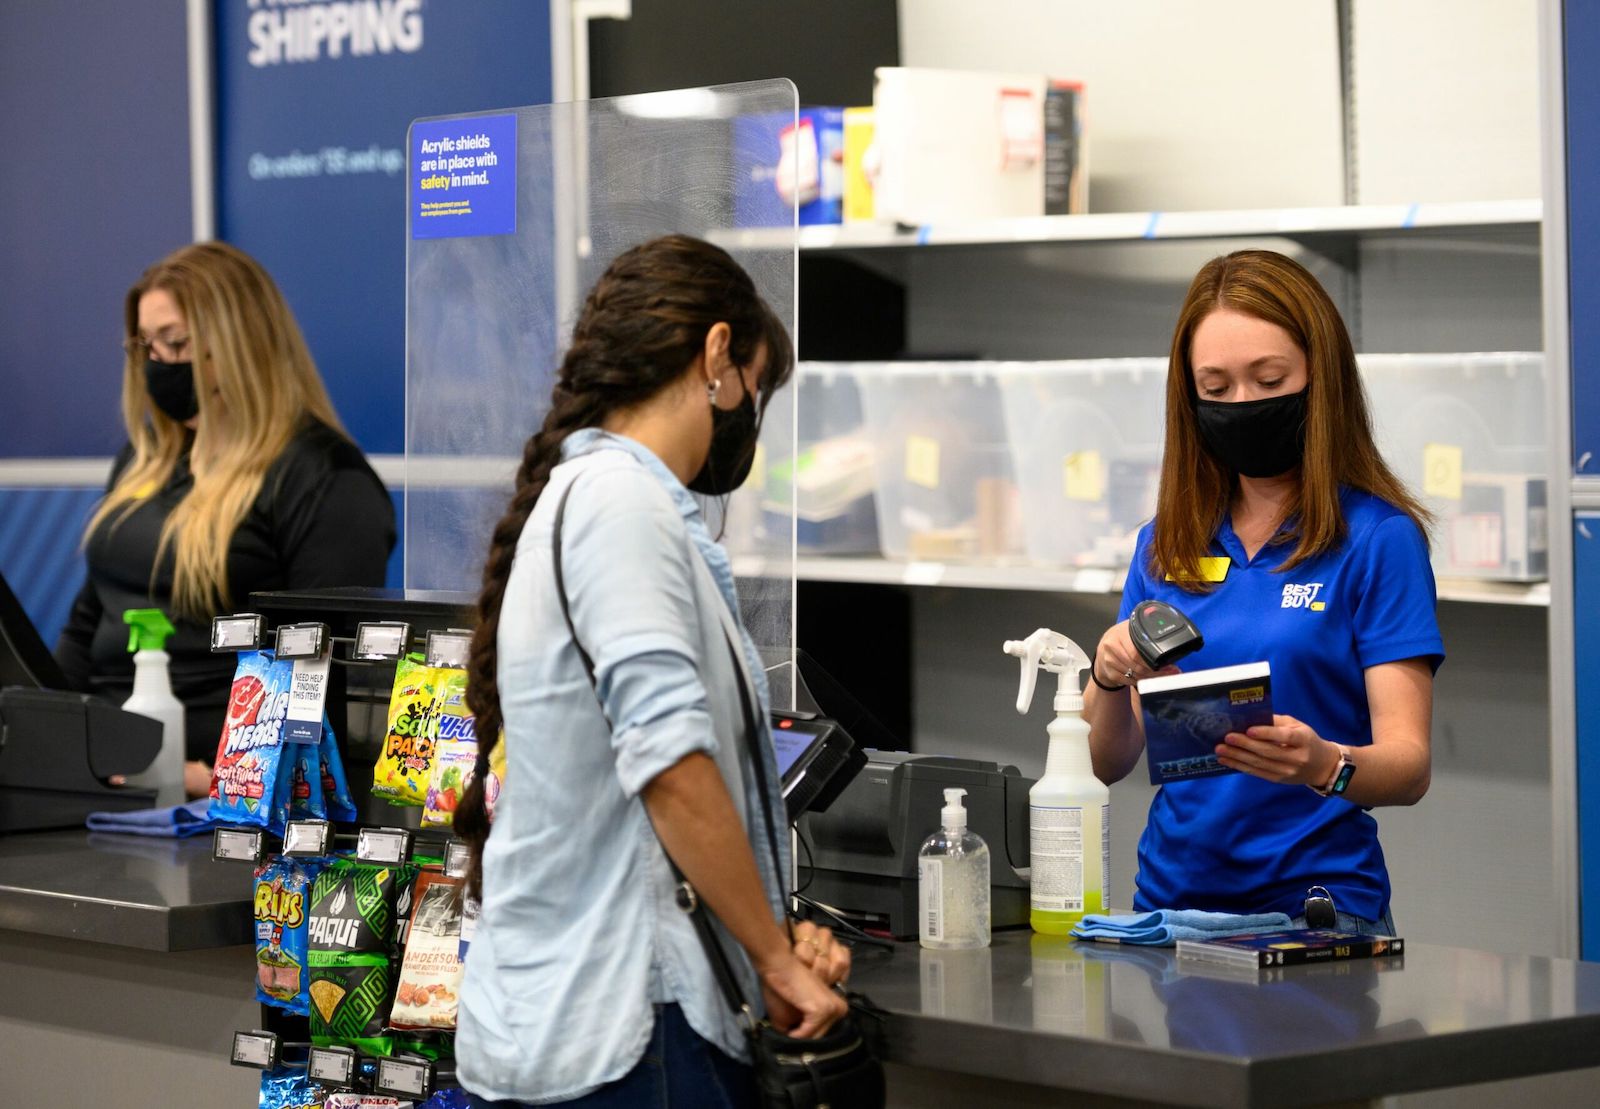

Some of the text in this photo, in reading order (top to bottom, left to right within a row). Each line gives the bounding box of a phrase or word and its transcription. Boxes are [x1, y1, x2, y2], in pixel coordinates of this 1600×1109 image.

[248, 1, 423, 66] SHIPPING
[421, 134, 490, 155] Acrylic shields
[421, 151, 497, 172] are in place with
[421, 170, 489, 191] safety in mind.
[1282, 583, 1323, 596] BEST
[1281, 595, 1315, 609] BUY
[295, 673, 323, 683] NEED HELP
[297, 682, 319, 692] FINDING
[256, 680, 289, 725] AIR
[293, 690, 321, 701] THIS ITEM?
[225, 720, 282, 755] HEADS
[216, 765, 262, 783] soft filled
[224, 779, 247, 797] bites
